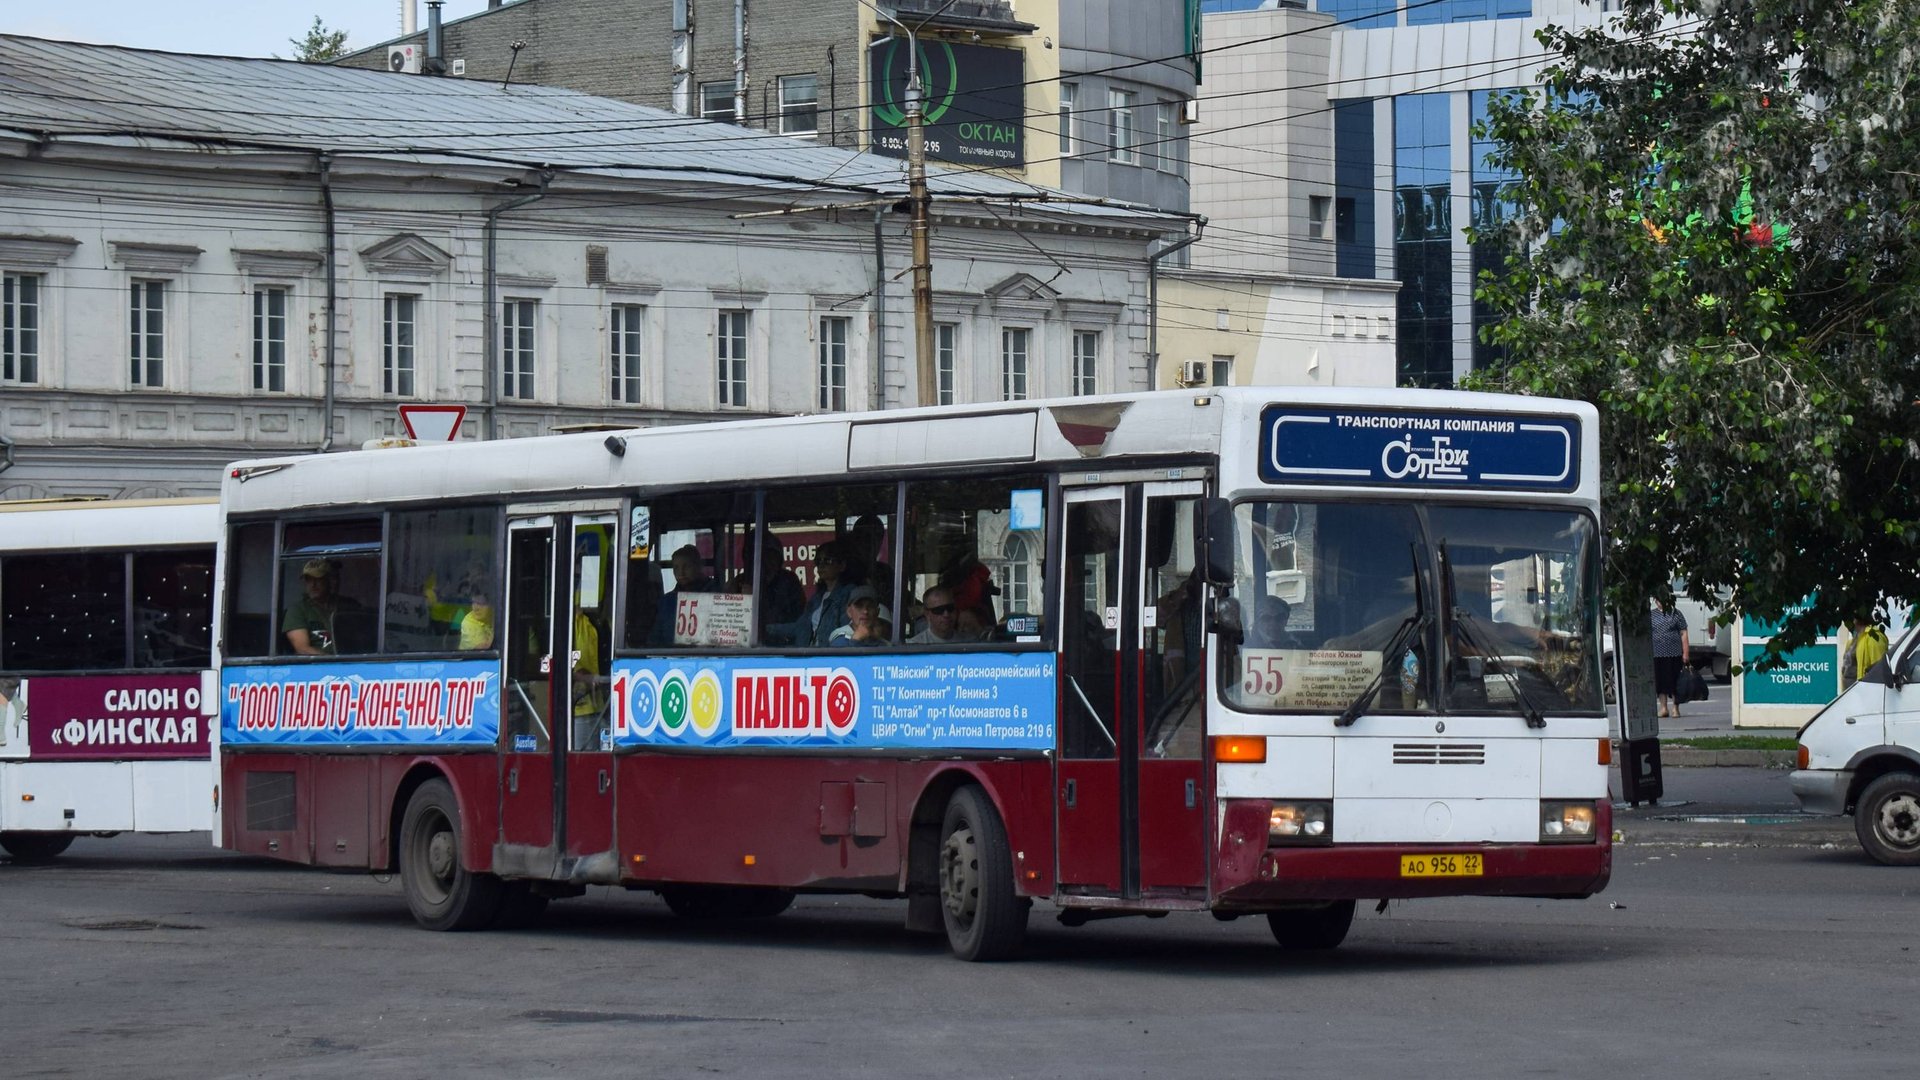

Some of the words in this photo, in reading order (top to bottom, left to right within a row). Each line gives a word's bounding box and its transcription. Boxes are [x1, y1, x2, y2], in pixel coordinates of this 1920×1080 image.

[959, 122, 1015, 144] ОКТАН
[931, 142, 940, 153] 95
[995, 149, 1015, 161] карты
[1336, 415, 1441, 430] ТРАНСПОРТНАЯ
[1443, 420, 1515, 433] КОМПАНИЯ
[677, 600, 698, 636] 55
[872, 666, 885, 681] ТЦ
[886, 665, 934, 680] "Майский"
[936, 668, 956, 681] пр-т
[957, 664, 1041, 681] Красноармейский
[1042, 664, 1053, 678] 64
[1245, 656, 1283, 696] 55
[1770, 675, 1811, 684] ТОВАРЫ
[104, 688, 179, 712] САЛОН
[735, 674, 857, 730] ПАЛЬТО
[872, 686, 885, 701] ТЦ
[886, 686, 896, 699] "7
[898, 685, 950, 699] Континент"
[955, 686, 990, 699] Ленина
[992, 686, 998, 699] 3
[229, 684, 279, 730] "1000
[872, 705, 885, 721] ТЦ
[886, 704, 923, 719] "Алтай"
[927, 708, 947, 721] пр-т
[949, 705, 1011, 719] Космонавтов
[1013, 706, 1019, 718] 6
[51, 716, 198, 745] «ФИНСКАЯ
[872, 723, 897, 739] ЦВИР
[900, 723, 931, 737] "Огни"
[932, 726, 947, 740] ул.
[949, 725, 982, 737] Антона
[985, 724, 1025, 739] Петрова
[1027, 724, 1043, 738] 219
[1408, 861, 1425, 873] АО
[1431, 857, 1456, 873] 956
[1464, 855, 1478, 868] 22
